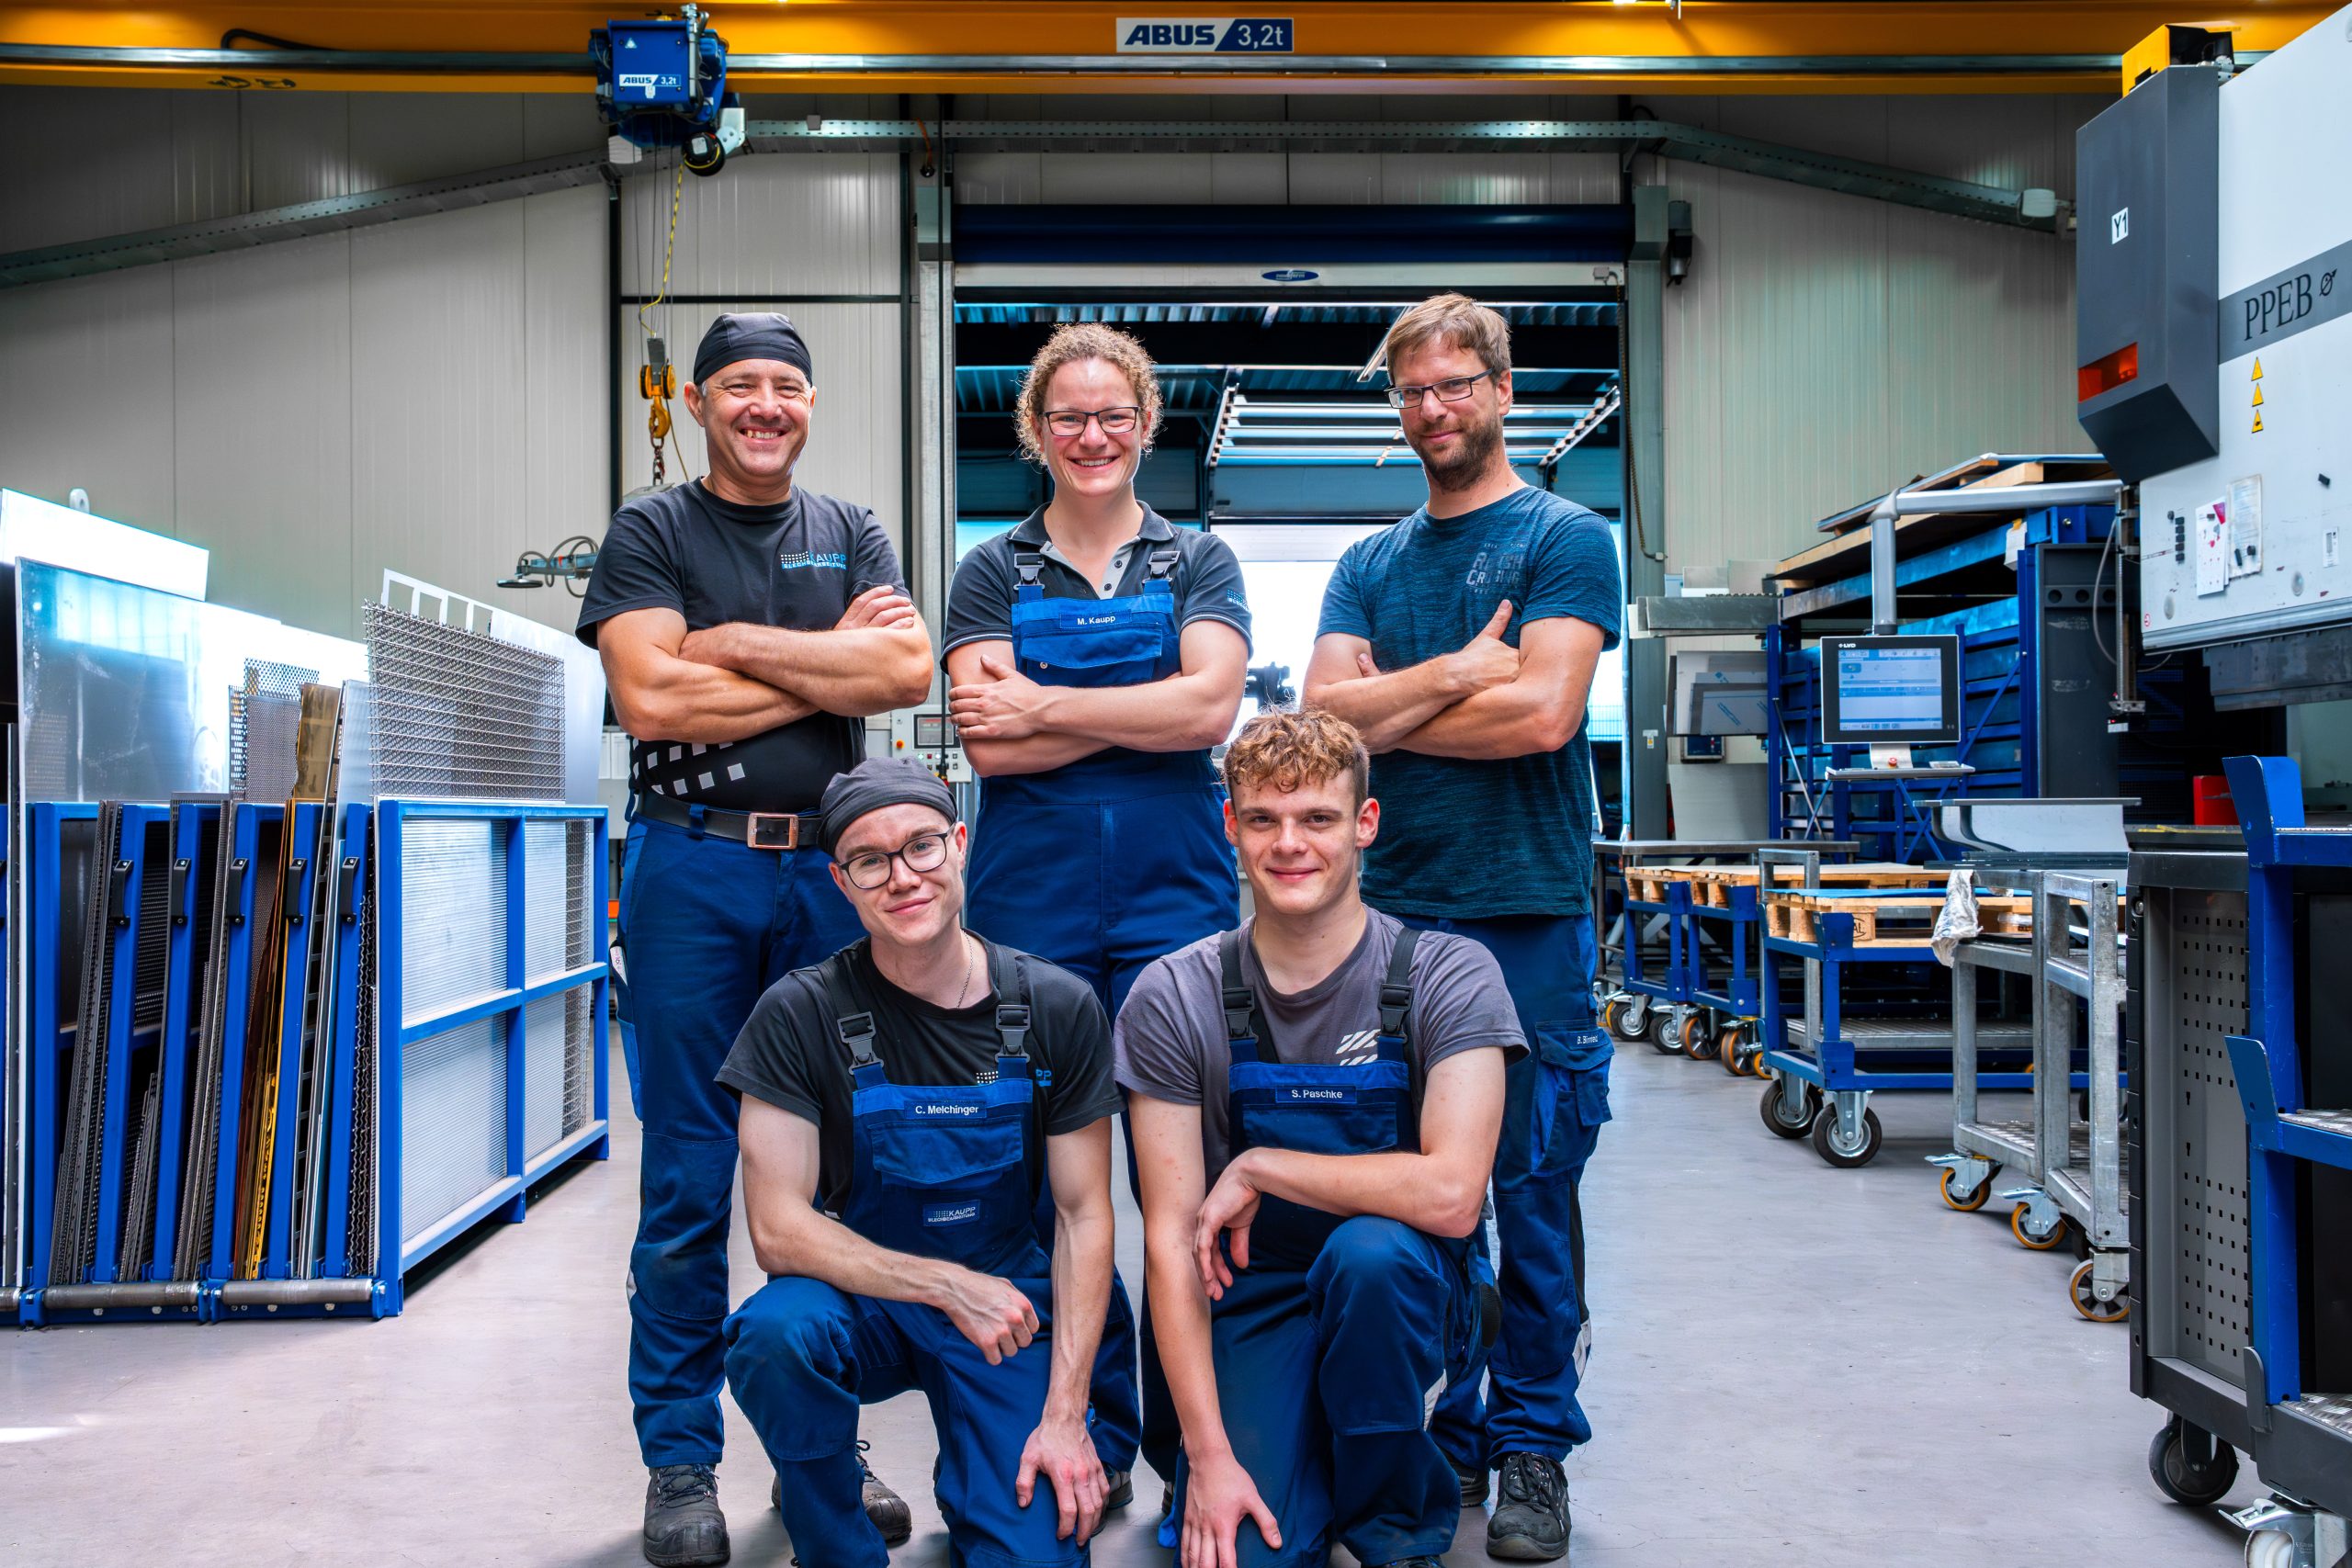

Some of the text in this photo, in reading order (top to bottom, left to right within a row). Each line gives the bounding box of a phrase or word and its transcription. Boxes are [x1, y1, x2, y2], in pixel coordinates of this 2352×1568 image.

[1125, 25, 1283, 49] ABUS 3,2t
[623, 76, 677, 85] ABUS 3,2t
[2113, 211, 2127, 239] Y1
[2244, 273, 2313, 342] PPEB
[1077, 615, 1116, 626] M. Kaupp
[1291, 1089, 1343, 1099] S. Paschke
[915, 1104, 979, 1116] C. Melchinger
[948, 1206, 976, 1217] KAUPP
